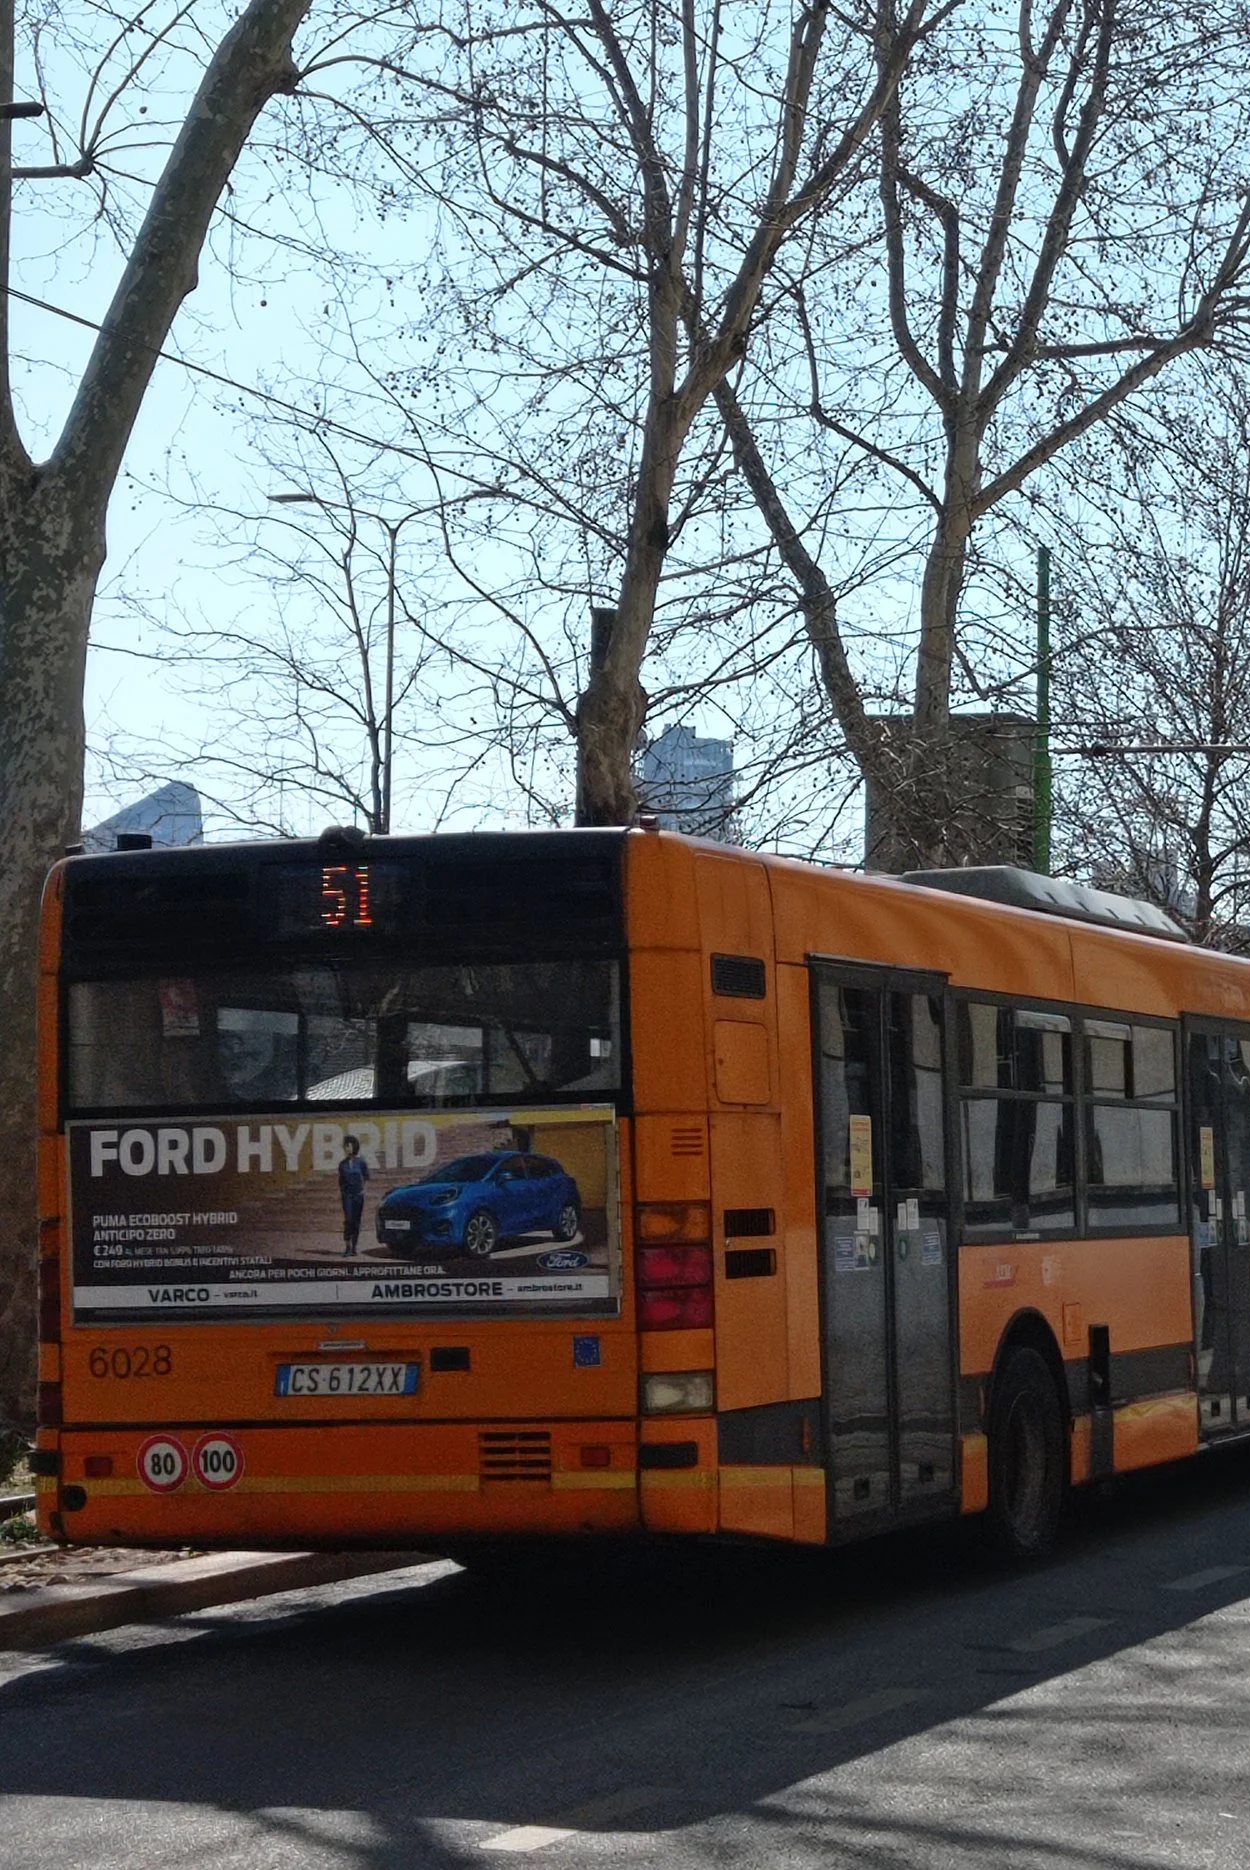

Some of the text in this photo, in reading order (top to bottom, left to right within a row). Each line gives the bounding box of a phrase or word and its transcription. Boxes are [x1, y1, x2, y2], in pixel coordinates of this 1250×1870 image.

[320, 866, 373, 925] 51
[90, 1121, 437, 1177] FORD HYBRID
[93, 1212, 238, 1227] PUMA ECOBOOST HYBRID
[93, 1228, 176, 1241] ANTICIPO ZERO
[240, 1256, 272, 1265] STATALI
[546, 1253, 580, 1268] Ford
[229, 1269, 267, 1279] ANCORA
[268, 1269, 285, 1279] PER
[287, 1268, 316, 1278] POCHI
[353, 1266, 422, 1277] APPROFITTANE
[148, 1288, 210, 1303] VARCO
[372, 1282, 503, 1299] AMBROSTORE
[517, 1283, 584, 1292] ambrostore.it
[88, 1345, 172, 1379] 6028
[151, 1452, 176, 1476] 80
[202, 1449, 235, 1473] 100
